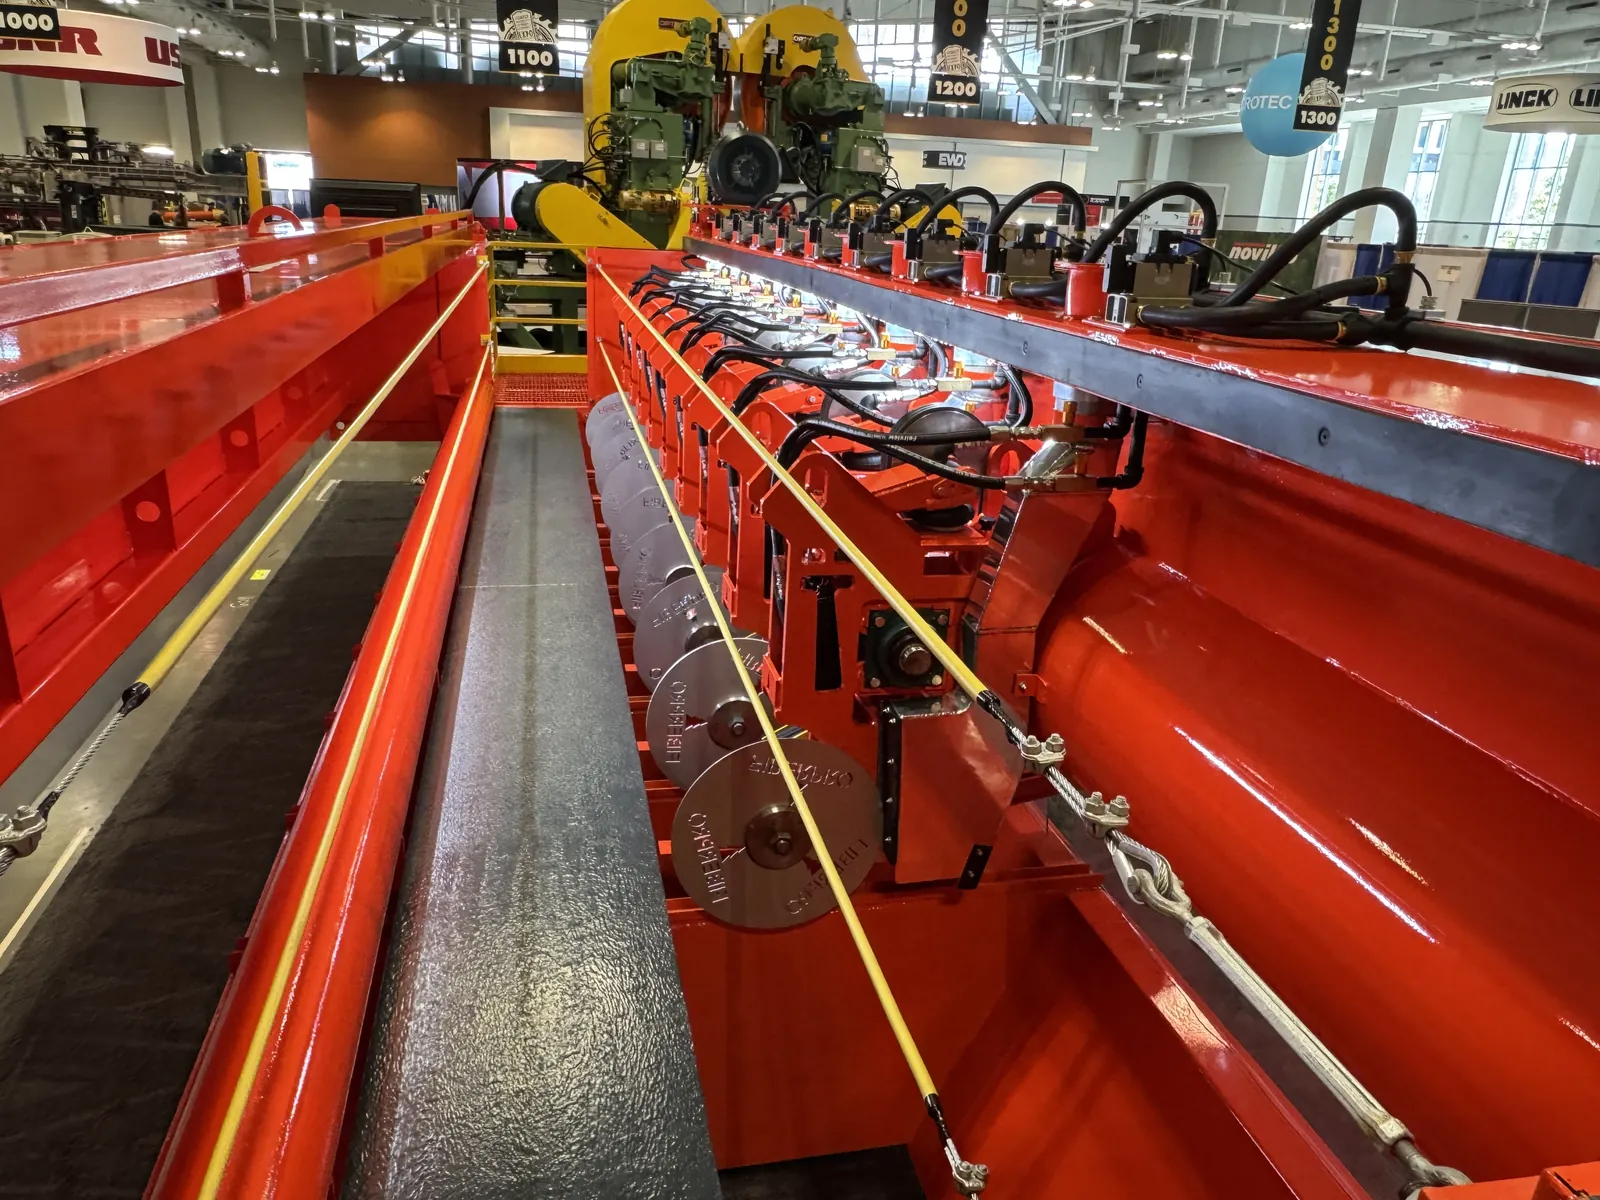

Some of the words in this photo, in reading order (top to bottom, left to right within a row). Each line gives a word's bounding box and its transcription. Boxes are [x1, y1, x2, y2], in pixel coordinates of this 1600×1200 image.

[507, 48, 553, 66] 1100
[935, 80, 977, 97] 1200
[1241, 95, 1293, 111] ROTEC
[1496, 88, 1555, 110] LINCK
[1300, 110, 1337, 126] 1300
[938, 152, 964, 167] EWD
